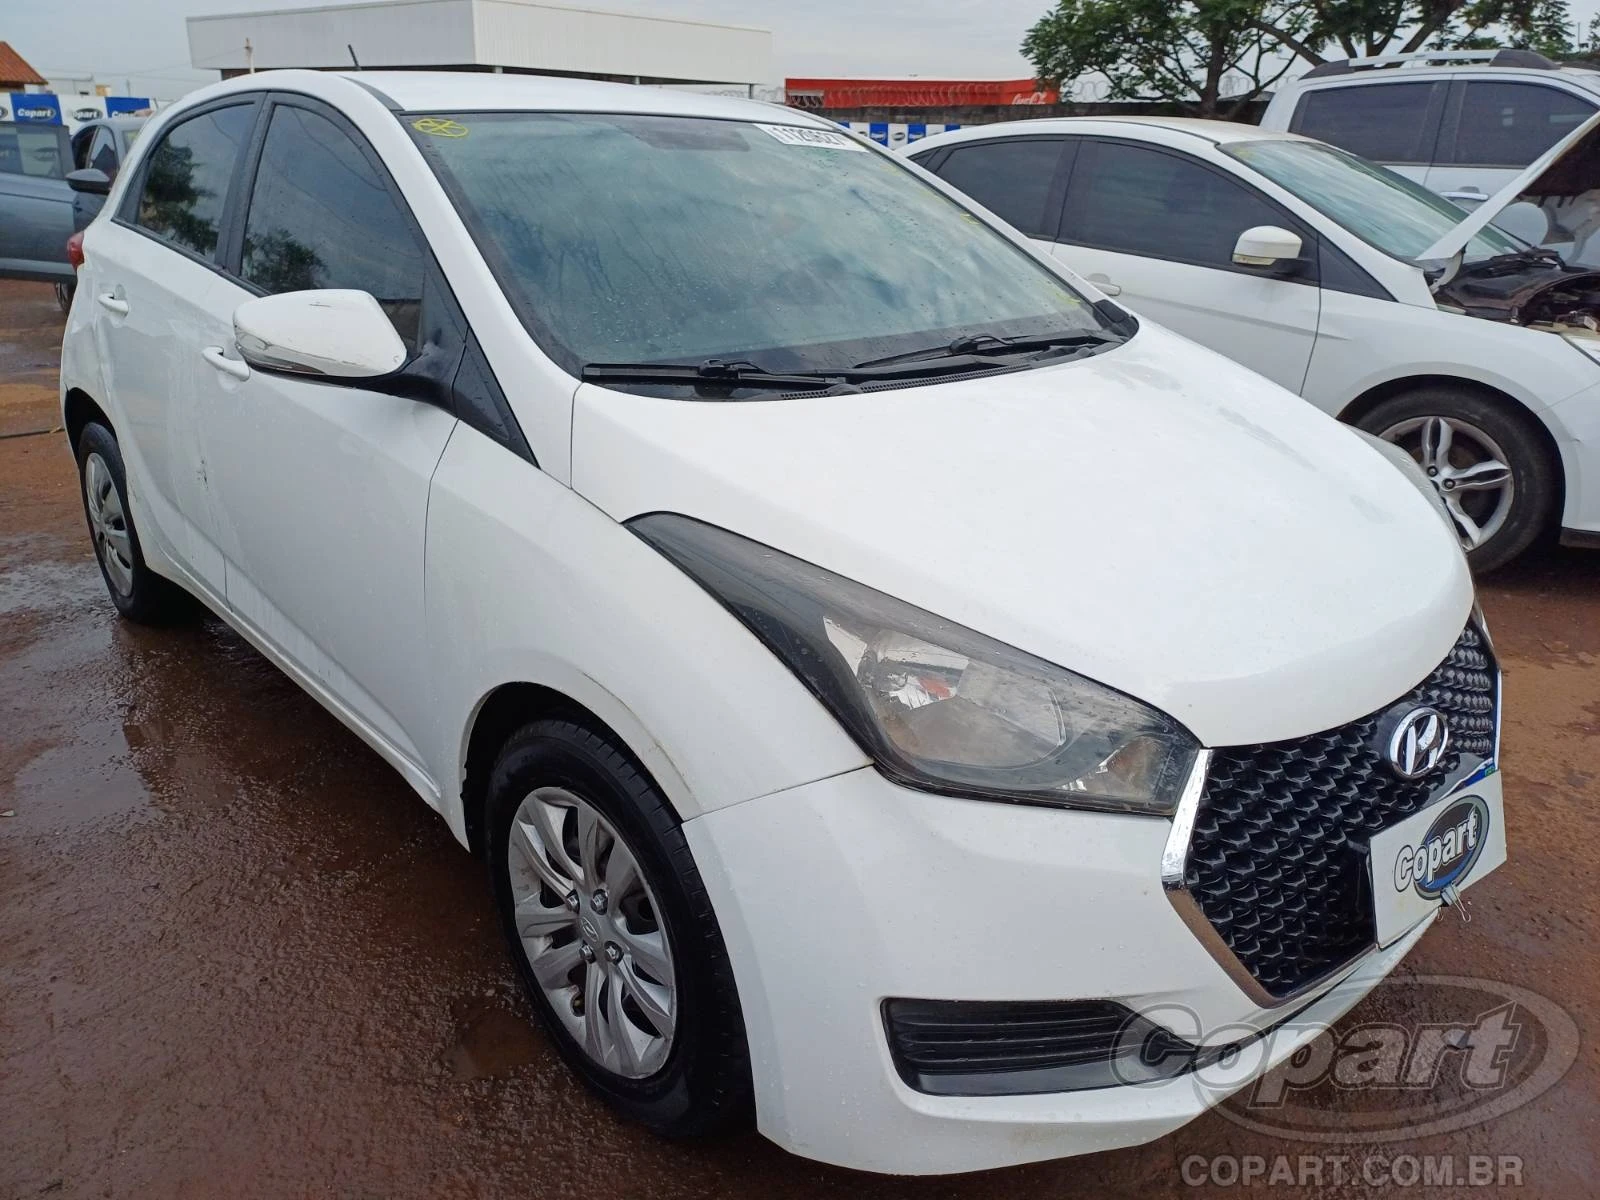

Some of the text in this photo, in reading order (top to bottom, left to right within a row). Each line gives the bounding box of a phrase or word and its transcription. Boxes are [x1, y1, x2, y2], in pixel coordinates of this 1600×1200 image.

[18, 108, 51, 118] Copart
[71, 110, 98, 119] opart
[1394, 803, 1478, 892] Copart
